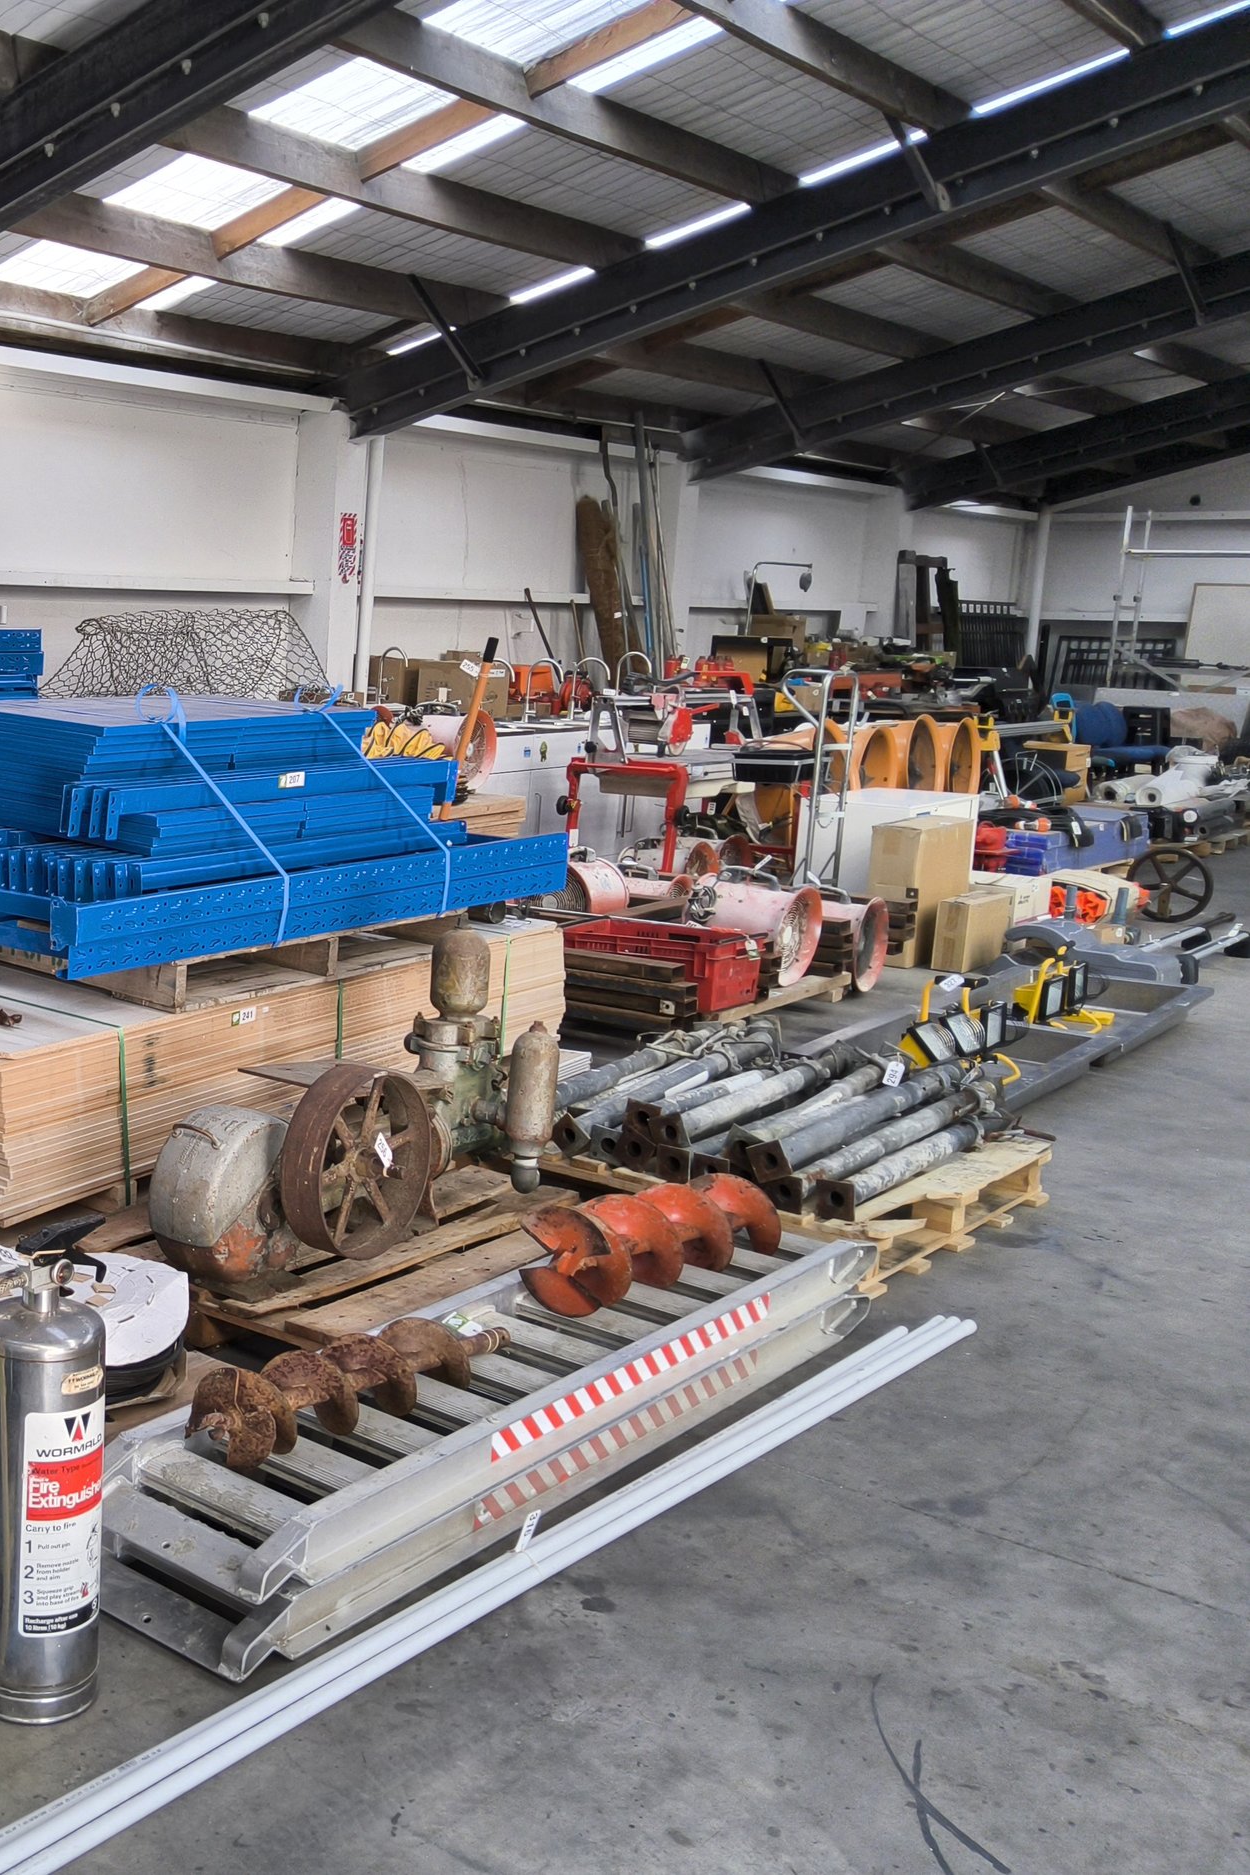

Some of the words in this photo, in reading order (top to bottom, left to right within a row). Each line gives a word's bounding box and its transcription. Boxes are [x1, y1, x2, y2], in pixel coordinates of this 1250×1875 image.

[242, 1010, 253, 1021] 241
[887, 1069, 899, 1085] 294
[36, 1433, 102, 1458] WORMALD
[62, 1464, 80, 1474] Type
[28, 1476, 60, 1493] Fire
[28, 1479, 102, 1509] Extinguishe
[25, 1524, 51, 1533] Carry
[63, 1522, 77, 1530] fire
[25, 1540, 32, 1553] 1
[24, 1565, 34, 1579] 2
[23, 1590, 34, 1605] 3
